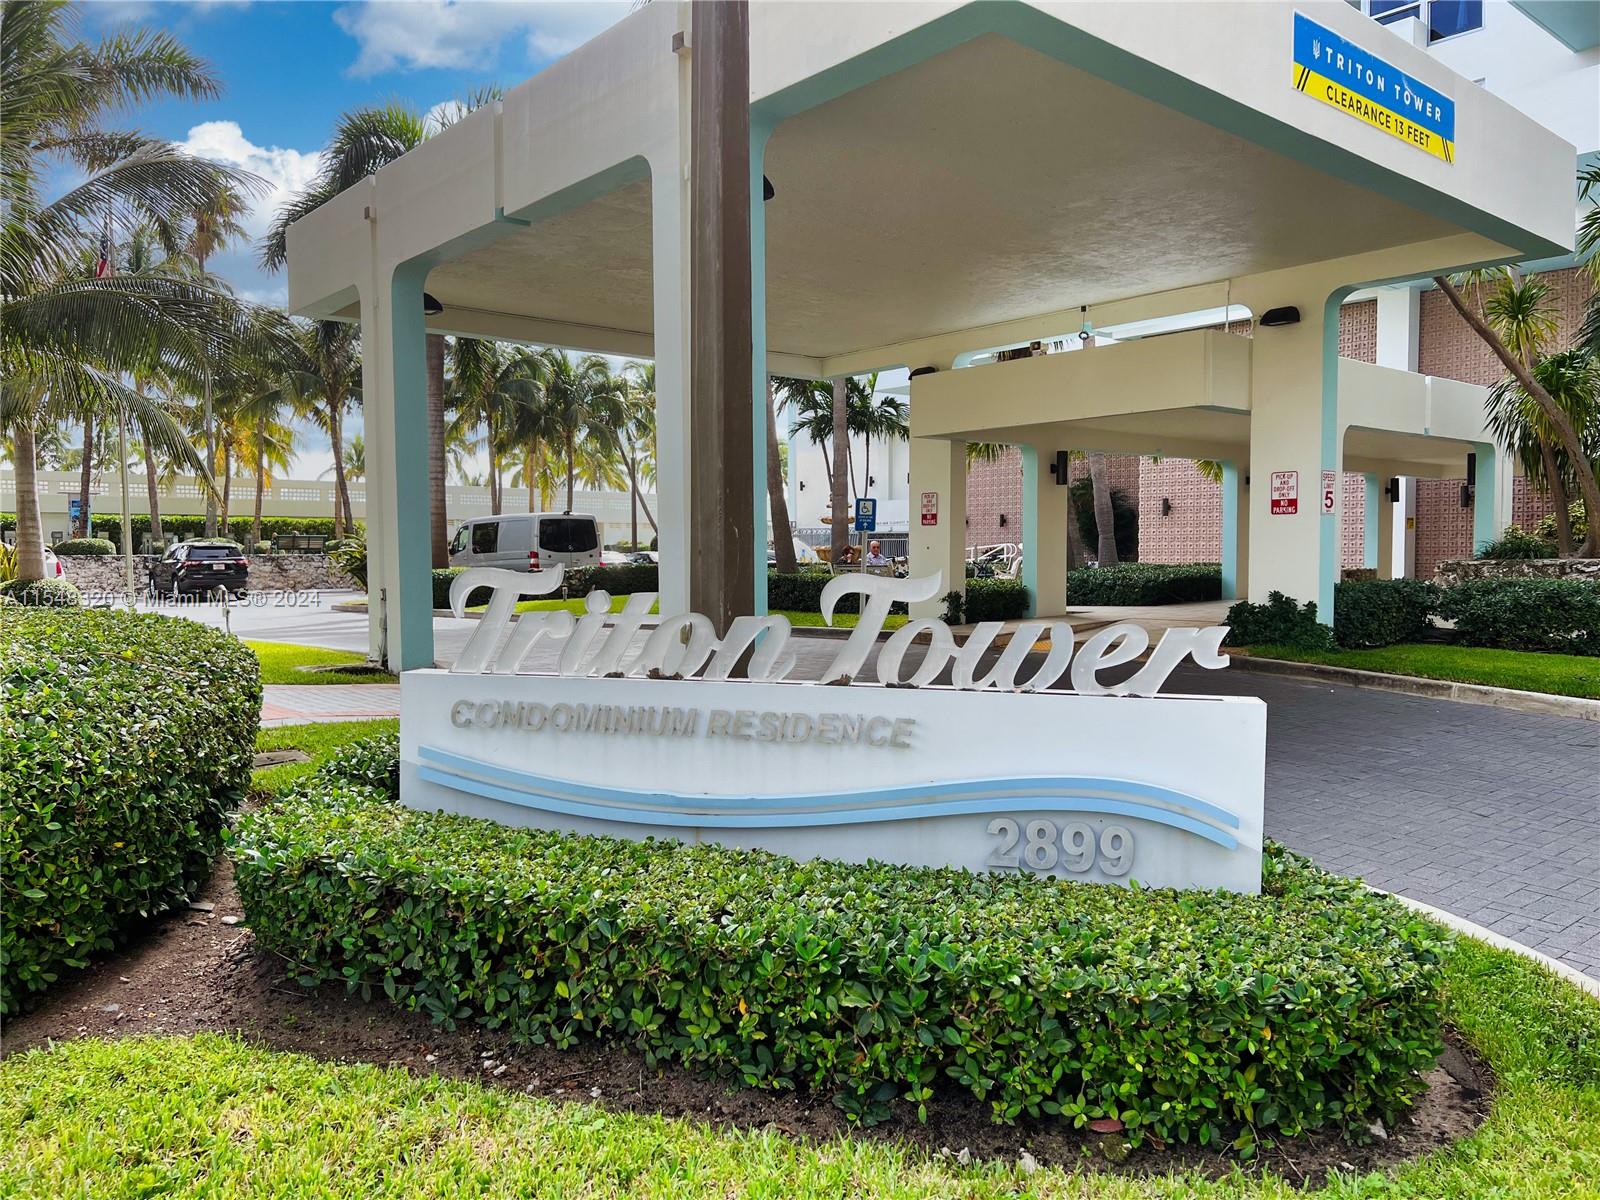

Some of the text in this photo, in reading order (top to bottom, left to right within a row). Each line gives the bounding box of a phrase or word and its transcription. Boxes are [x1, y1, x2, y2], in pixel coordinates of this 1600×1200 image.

[1326, 47, 1441, 122] TRITON TOWER
[1326, 85, 1430, 148] CLEARANCE 13 FEET
[1322, 472, 1335, 481] SPEED
[1324, 490, 1333, 508] 5
[449, 563, 1230, 697] Triton Tower
[450, 699, 917, 750] CONDOMINIUM RESIDENCE
[986, 817, 1134, 876] 2899
